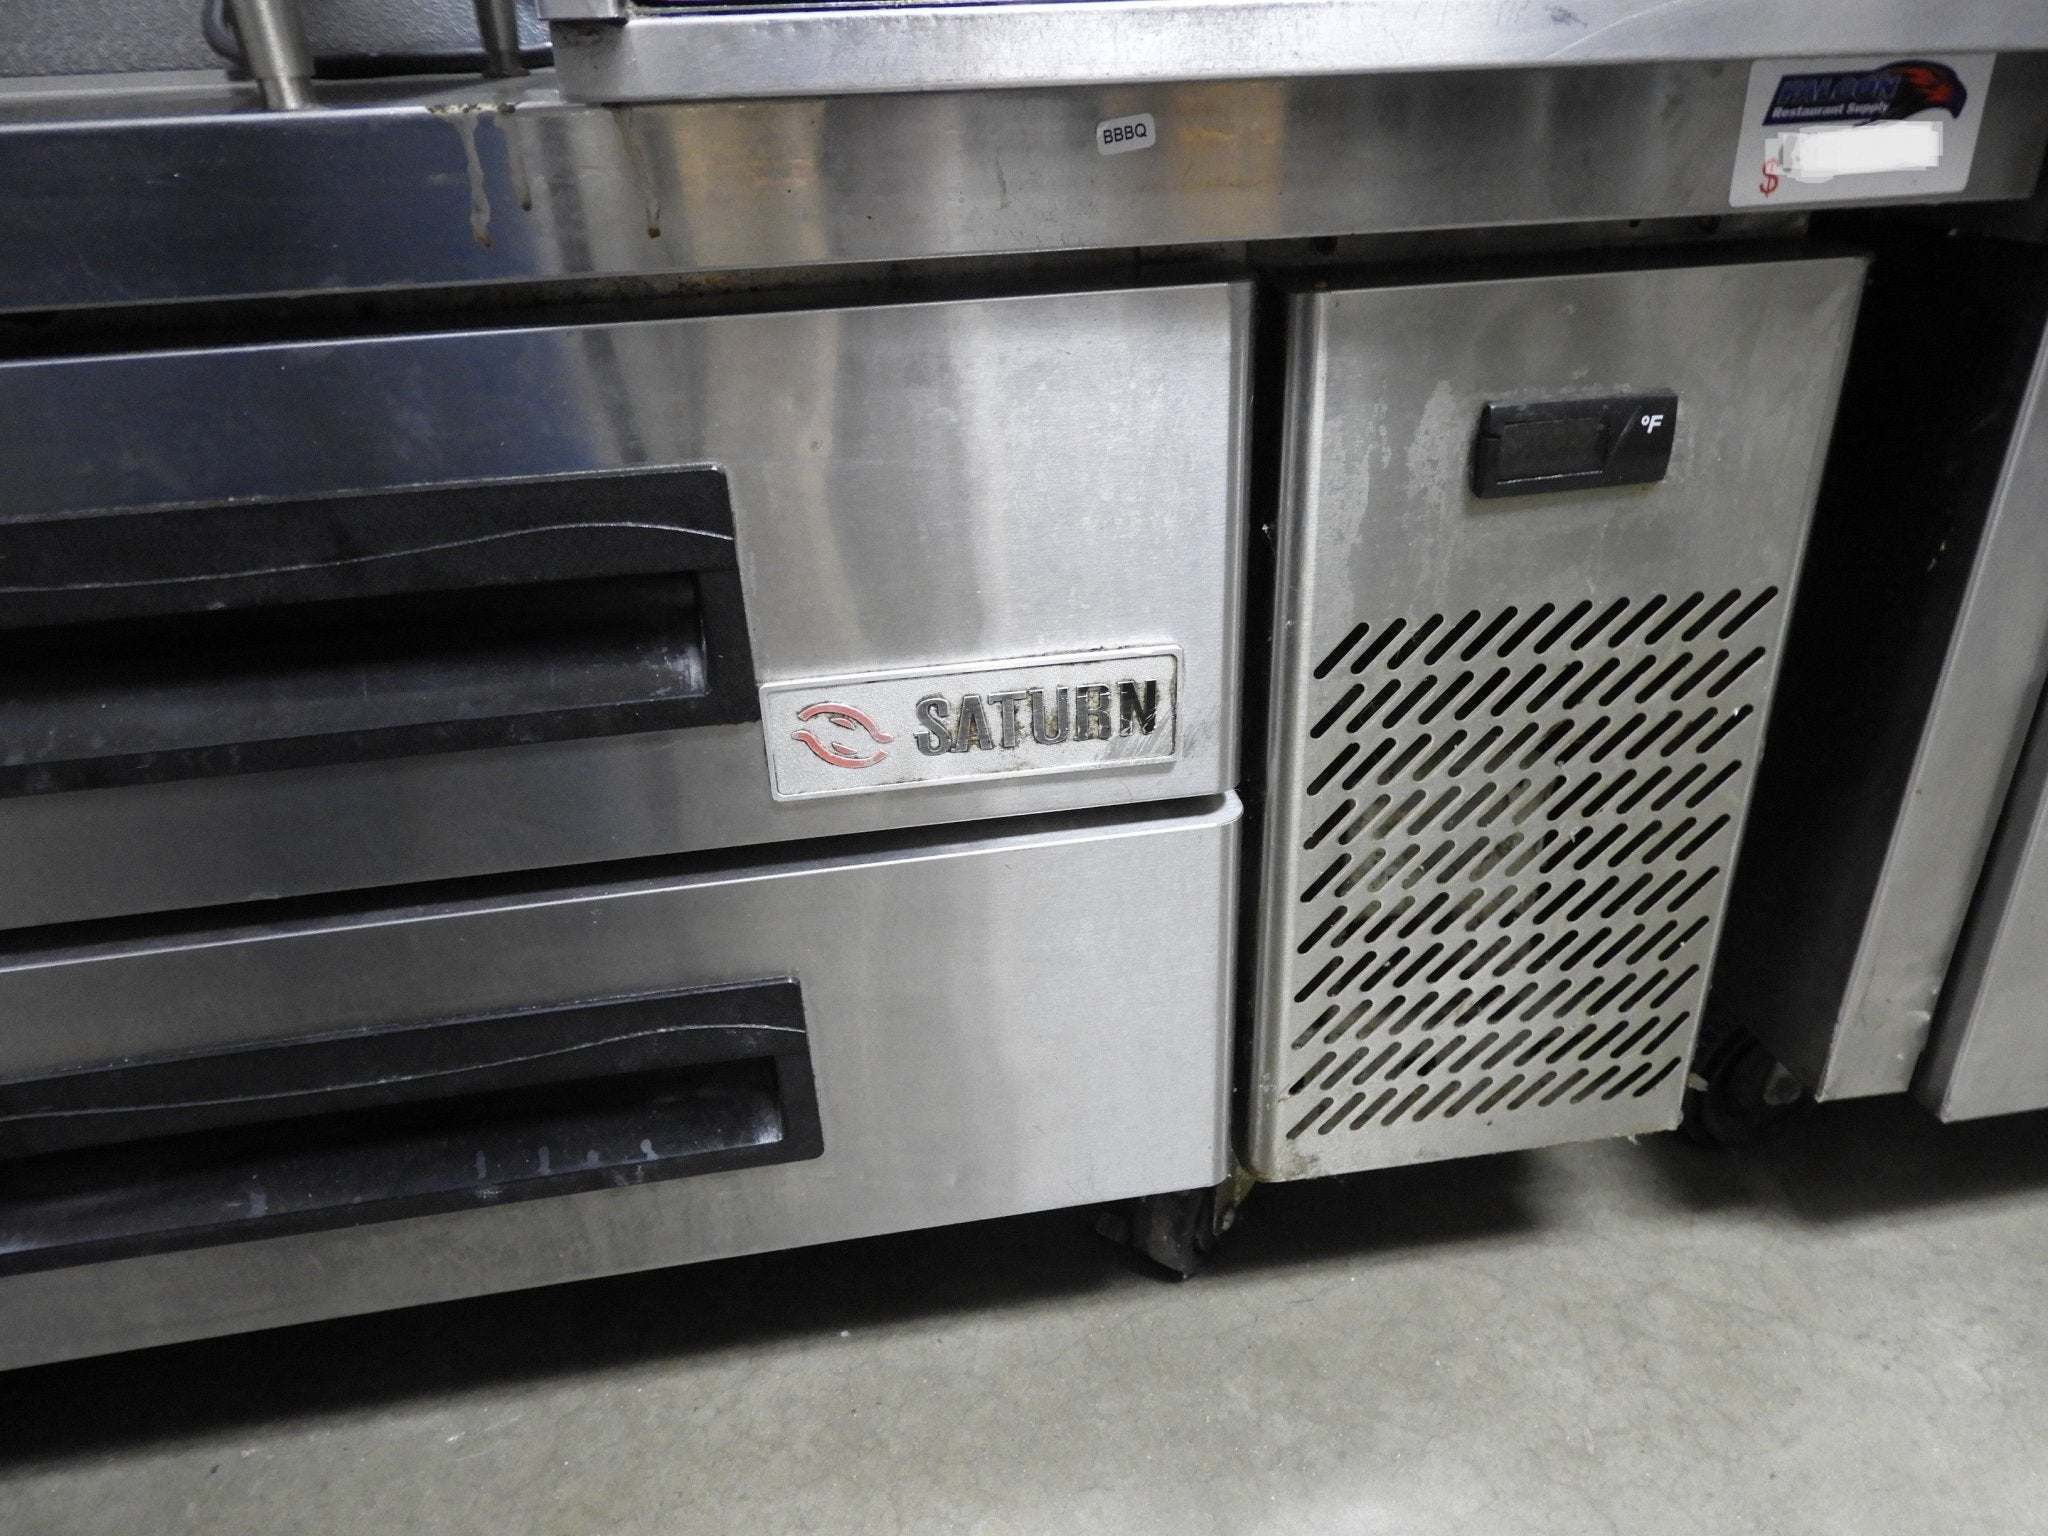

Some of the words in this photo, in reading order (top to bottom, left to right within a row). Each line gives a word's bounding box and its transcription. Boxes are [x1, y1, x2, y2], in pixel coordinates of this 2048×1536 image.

[1771, 103, 1845, 118] Restaurant
[1846, 101, 1890, 115] Supply
[1103, 123, 1147, 144] BBBQ
[1759, 157, 1780, 198] $
[912, 680, 1158, 757] SATURN
